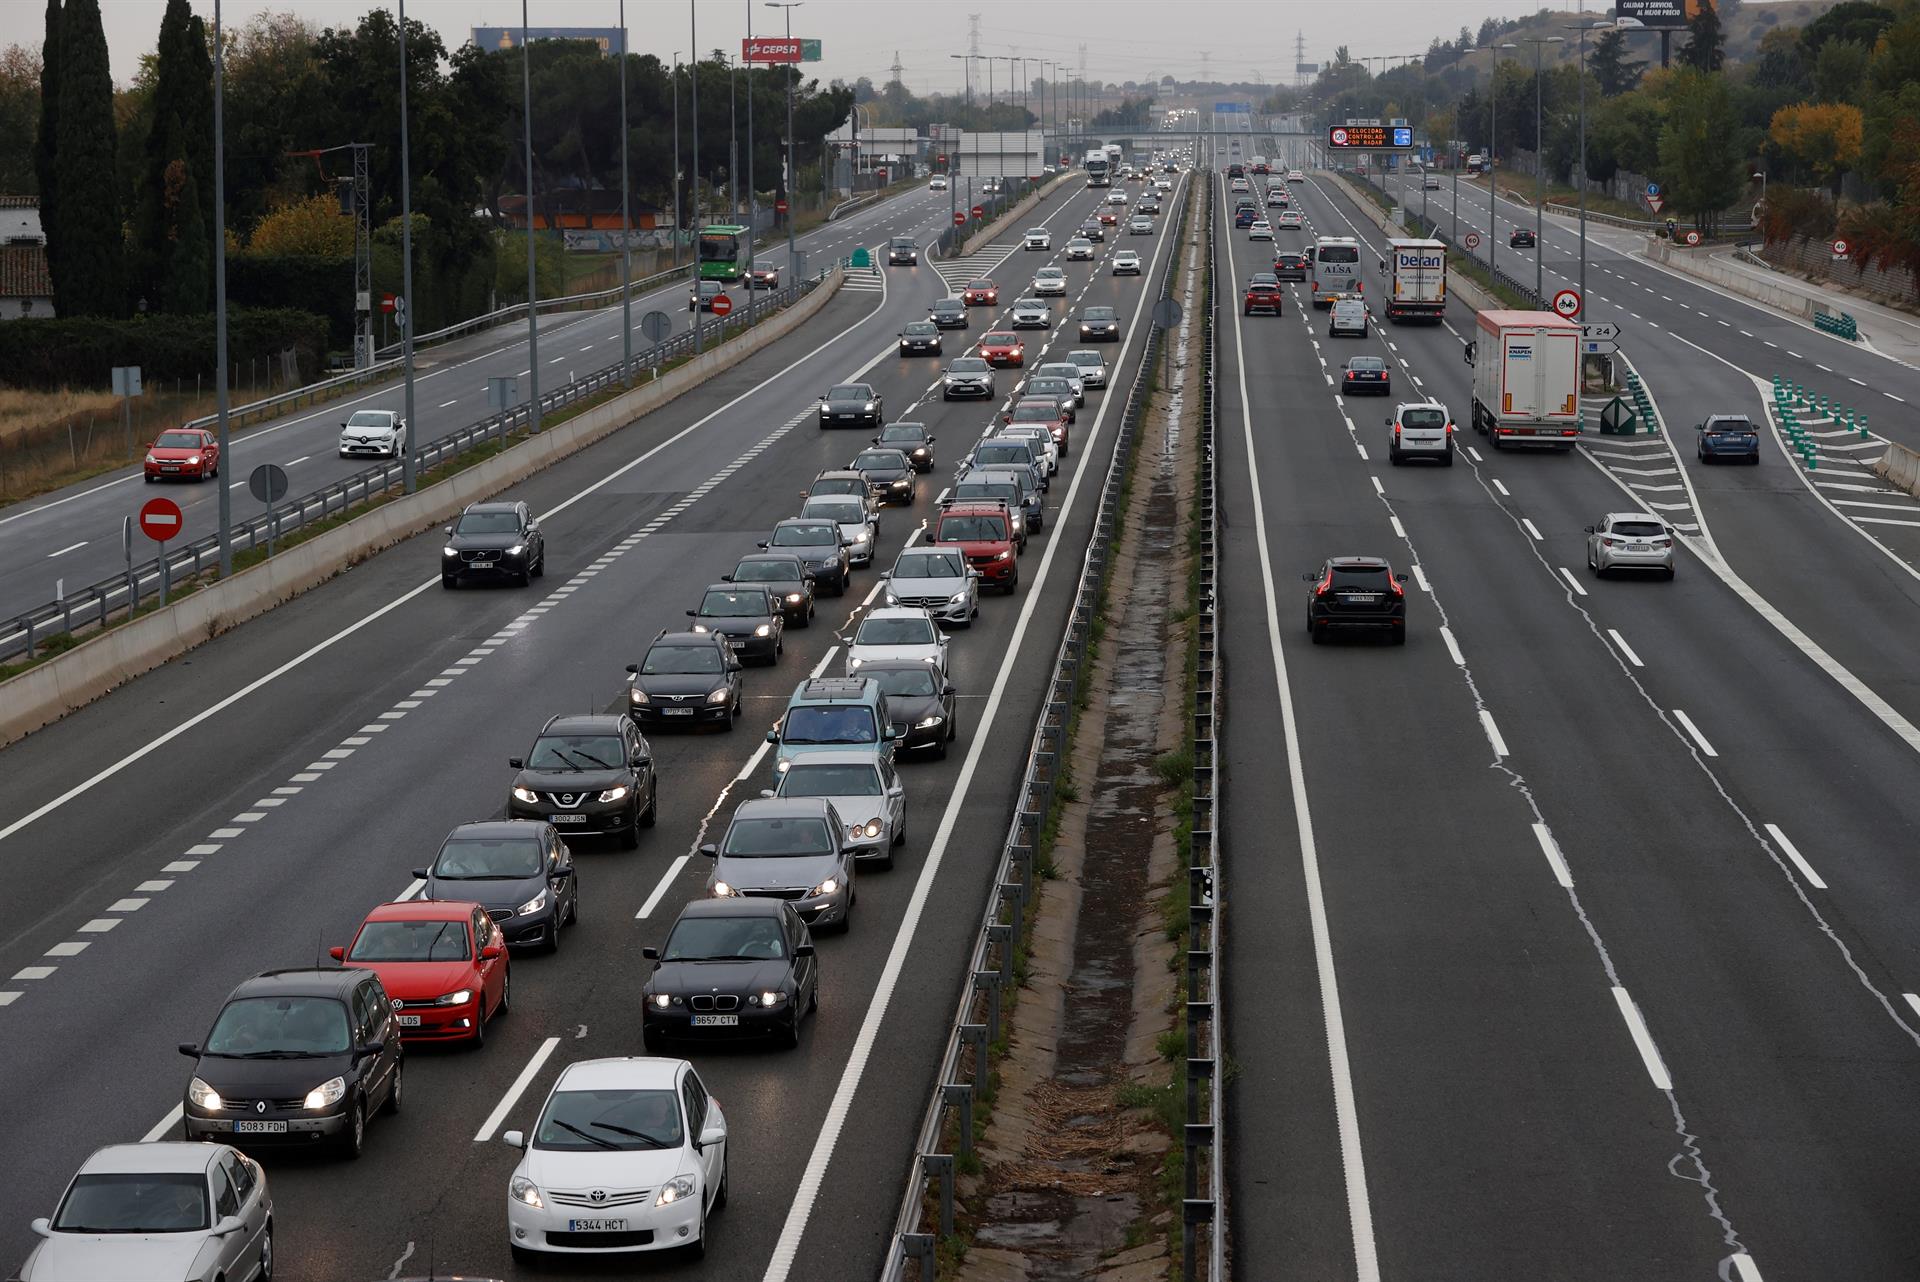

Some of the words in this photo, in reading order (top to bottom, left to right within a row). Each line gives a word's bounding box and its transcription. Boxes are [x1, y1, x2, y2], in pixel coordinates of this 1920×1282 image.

[762, 46, 798, 54] CEPSA
[1400, 254, 1440, 266] beran
[402, 1016, 418, 1024] LDS
[240, 1122, 264, 1131] 5083
[268, 1122, 286, 1131] FDH
[576, 1220, 601, 1230] 5344
[604, 1220, 624, 1230] HCT
